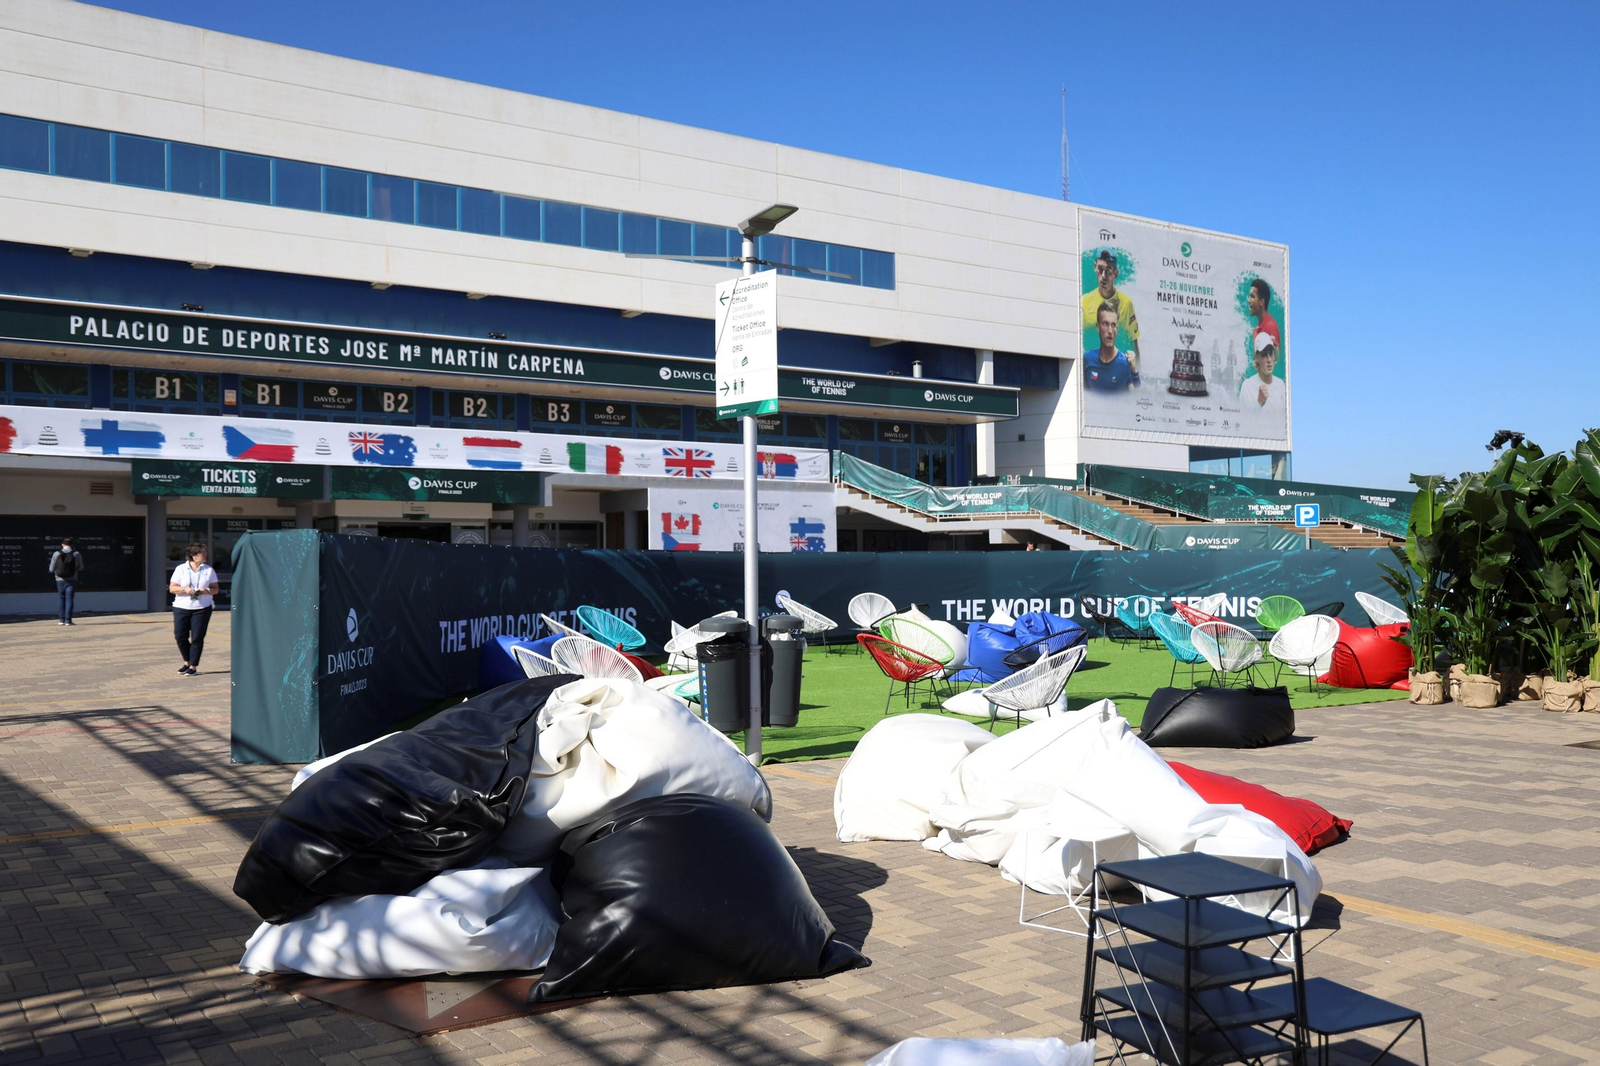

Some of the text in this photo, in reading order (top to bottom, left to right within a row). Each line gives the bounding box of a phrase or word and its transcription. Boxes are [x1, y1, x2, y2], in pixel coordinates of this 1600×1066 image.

[1162, 257, 1211, 273] DAVIS CUP
[732, 281, 768, 295] Accreditation
[1160, 280, 1214, 296] 21-26 NOVIEMBRE
[732, 294, 748, 305] Office
[1157, 292, 1218, 310] MARTÍN CARPENA
[732, 310, 765, 321] Acreditaciones
[732, 320, 766, 333] Ticket Office
[732, 334, 744, 342] Venta
[752, 328, 772, 338] Entradas
[70, 315, 169, 342] PALACIO
[183, 325, 210, 346] DE
[222, 328, 330, 354] DEPORTES
[340, 339, 389, 361] JOSE
[432, 347, 499, 368] MARTÍN
[508, 353, 585, 376] CARPENA
[732, 344, 743, 354] ORG
[673, 370, 716, 382] DAVIS CU
[802, 377, 856, 389] THE WORLD CUP
[156, 376, 181, 400] B1
[257, 384, 280, 406] B1
[822, 386, 847, 396] TENNIS
[383, 392, 409, 414] B2
[934, 393, 956, 402] DAVIS
[463, 397, 488, 418] B2
[548, 402, 570, 422] B3
[201, 468, 256, 484] TICKETS
[201, 485, 258, 494] VENTA ENTRADAS
[423, 480, 477, 490] DAVIS CUP
[1300, 506, 1315, 524] P
[942, 599, 986, 620] THE
[992, 598, 1075, 620] WORLD
[440, 619, 468, 653] THE
[470, 615, 514, 649] WORLD
[517, 612, 543, 640] CUP
[328, 646, 374, 675] DAVIS CUP
[340, 678, 368, 696] FINALS 2023
